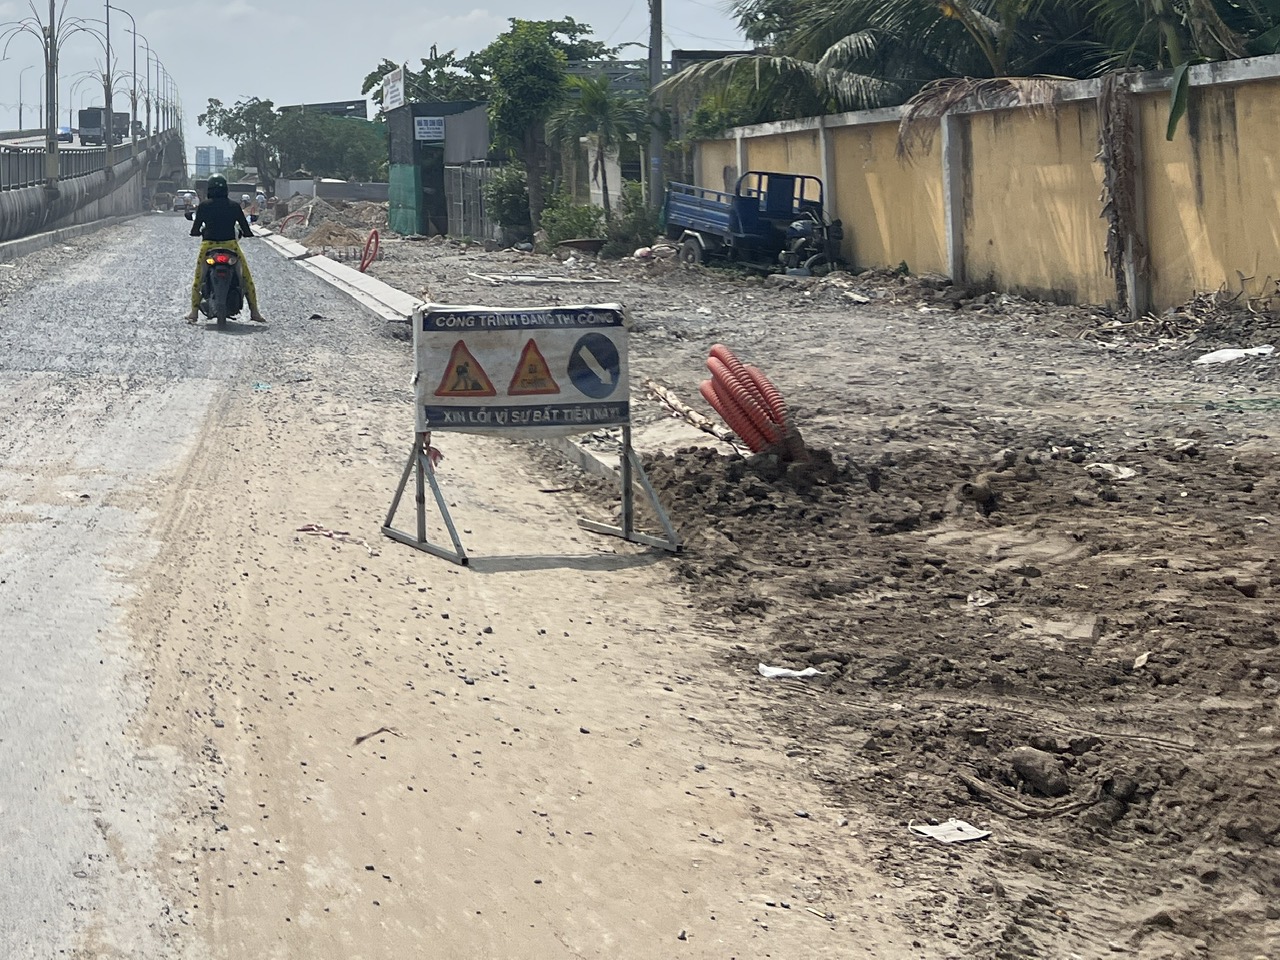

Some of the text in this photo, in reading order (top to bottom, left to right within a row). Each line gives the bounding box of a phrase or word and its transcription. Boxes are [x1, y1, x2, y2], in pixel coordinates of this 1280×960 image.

[435, 311, 615, 327] CÔNG TRÌNH ĐANG THI CÔNG
[443, 411, 466, 423] XIN
[532, 406, 560, 422] BẤT
